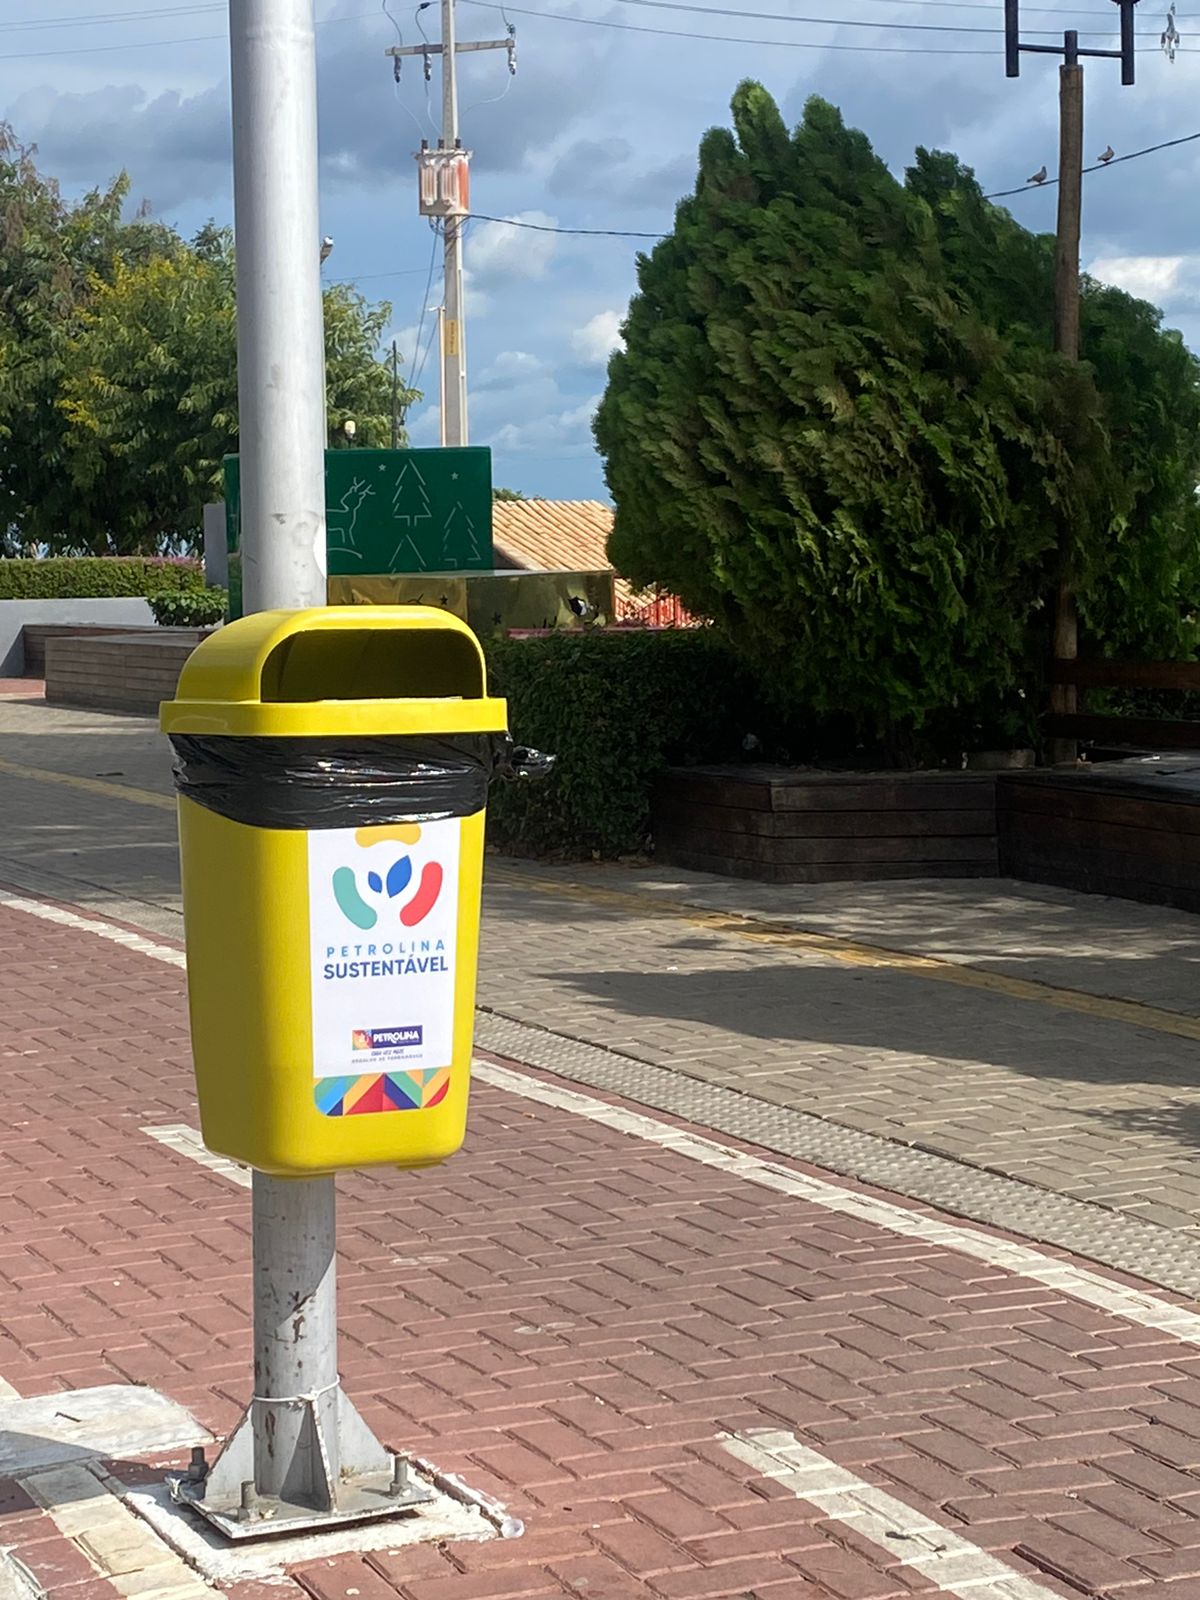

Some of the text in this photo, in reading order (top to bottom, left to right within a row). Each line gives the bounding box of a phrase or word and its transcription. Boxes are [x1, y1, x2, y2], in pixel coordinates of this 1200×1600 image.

[327, 939, 445, 958] PETROLINA
[323, 954, 449, 980] SUSTENTÁVEL
[373, 1030, 420, 1044] PETROLINA
